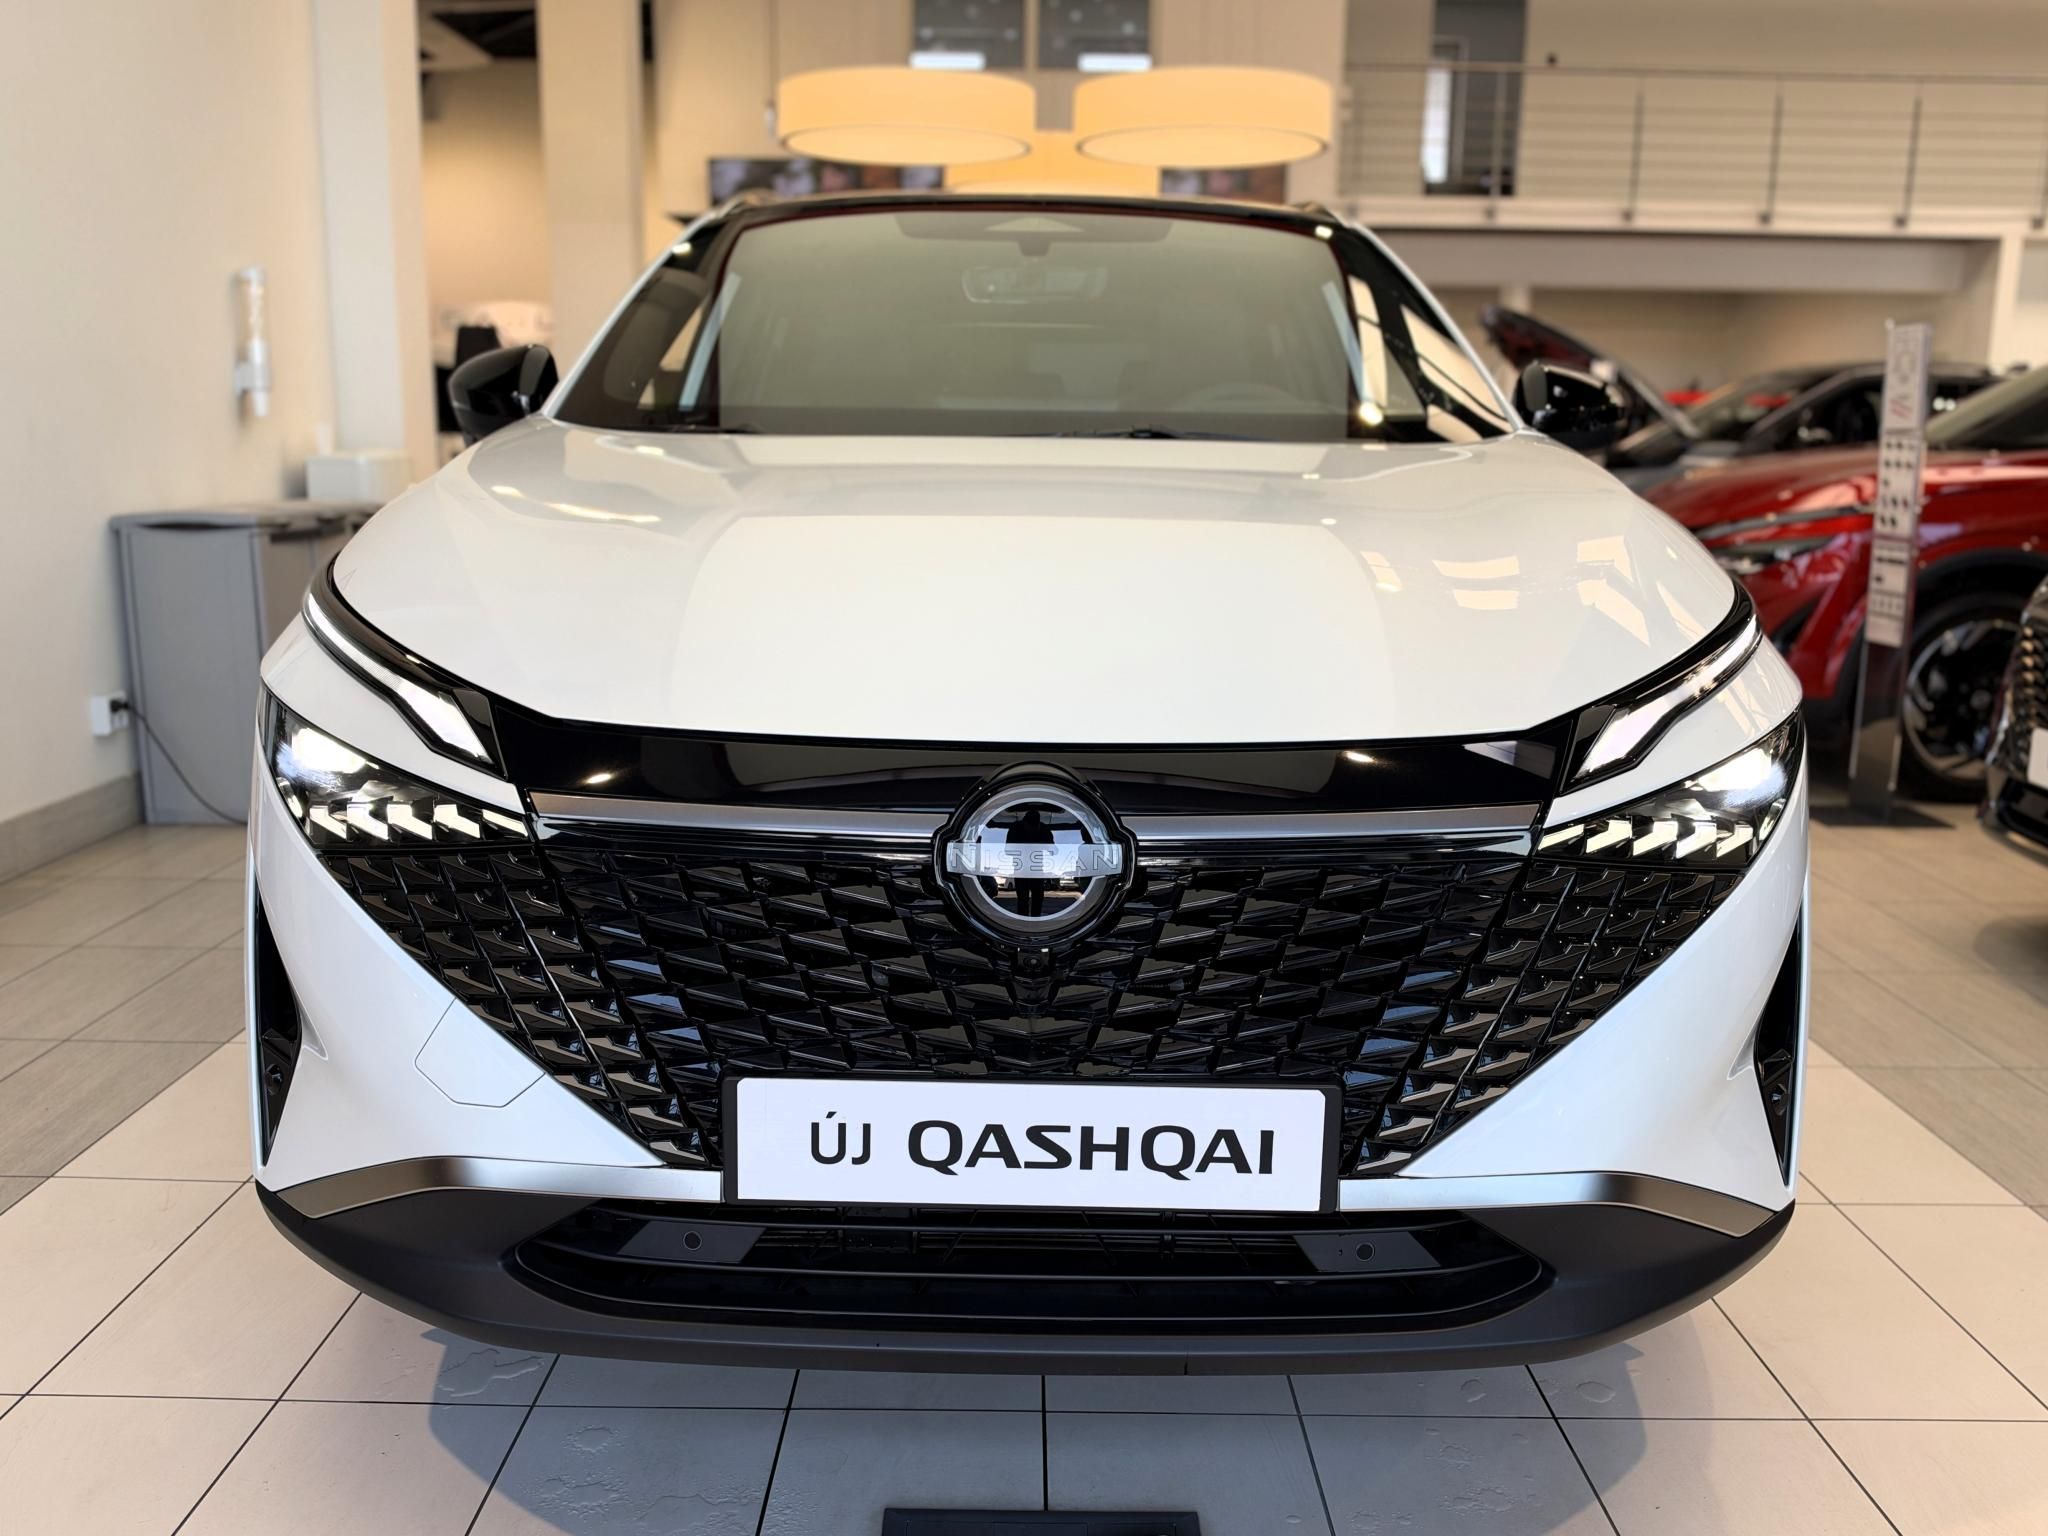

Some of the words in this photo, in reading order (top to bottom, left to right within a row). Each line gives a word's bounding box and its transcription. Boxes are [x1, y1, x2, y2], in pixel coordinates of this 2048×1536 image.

[950, 845, 1119, 871] NISSAN
[810, 1111, 871, 1165] ÚJ
[908, 1119, 1275, 1181] QASHQAI
